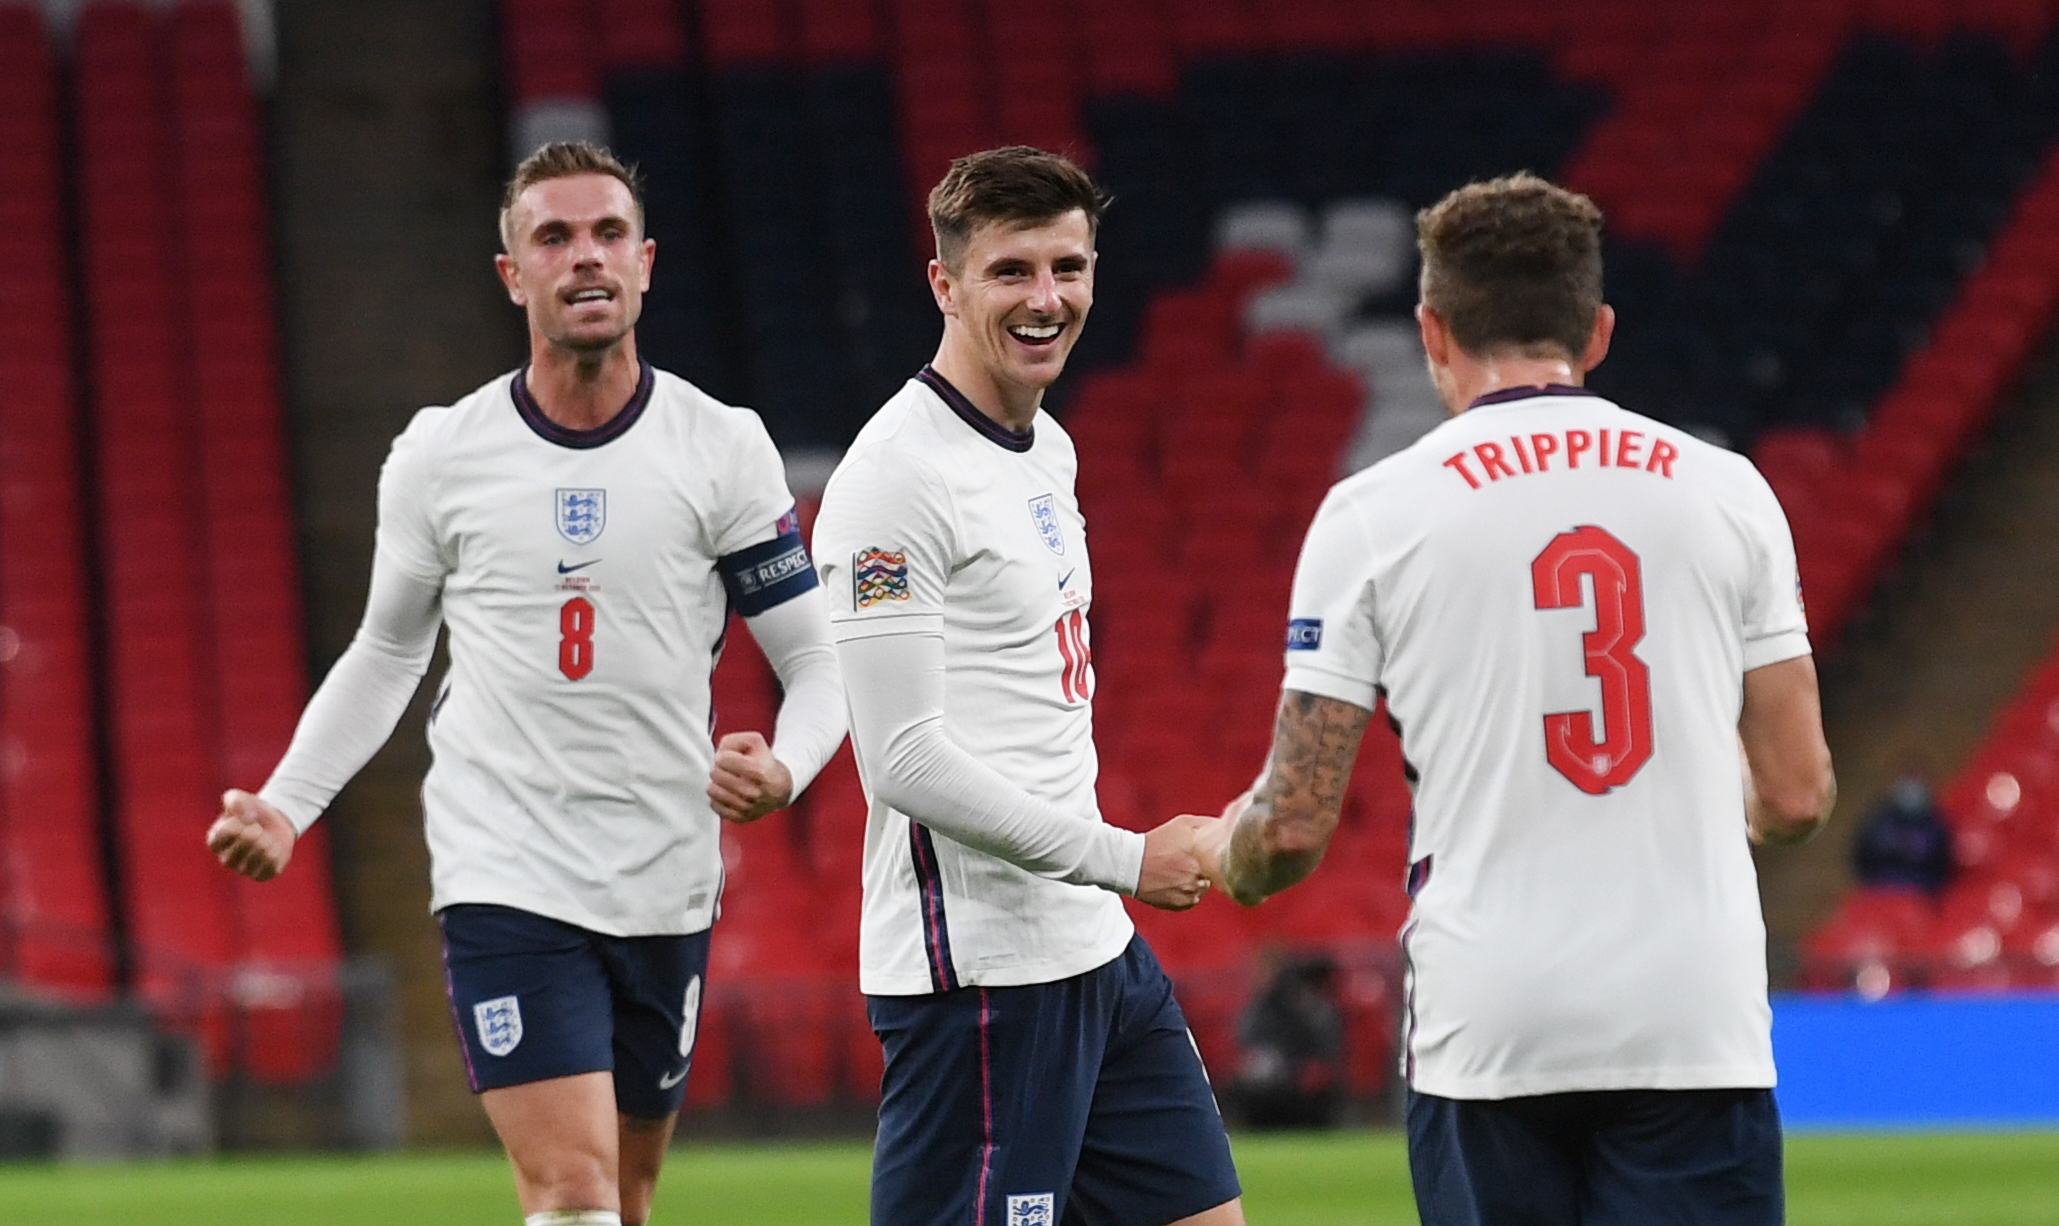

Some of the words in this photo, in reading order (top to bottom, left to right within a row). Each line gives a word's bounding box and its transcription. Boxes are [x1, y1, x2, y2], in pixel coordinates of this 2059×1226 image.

[1443, 428, 1679, 490] TRIPPIER
[559, 596, 595, 681] 8
[1055, 609, 1091, 703] 10
[1531, 525, 1654, 795] 3
[679, 973, 701, 1058] 8
